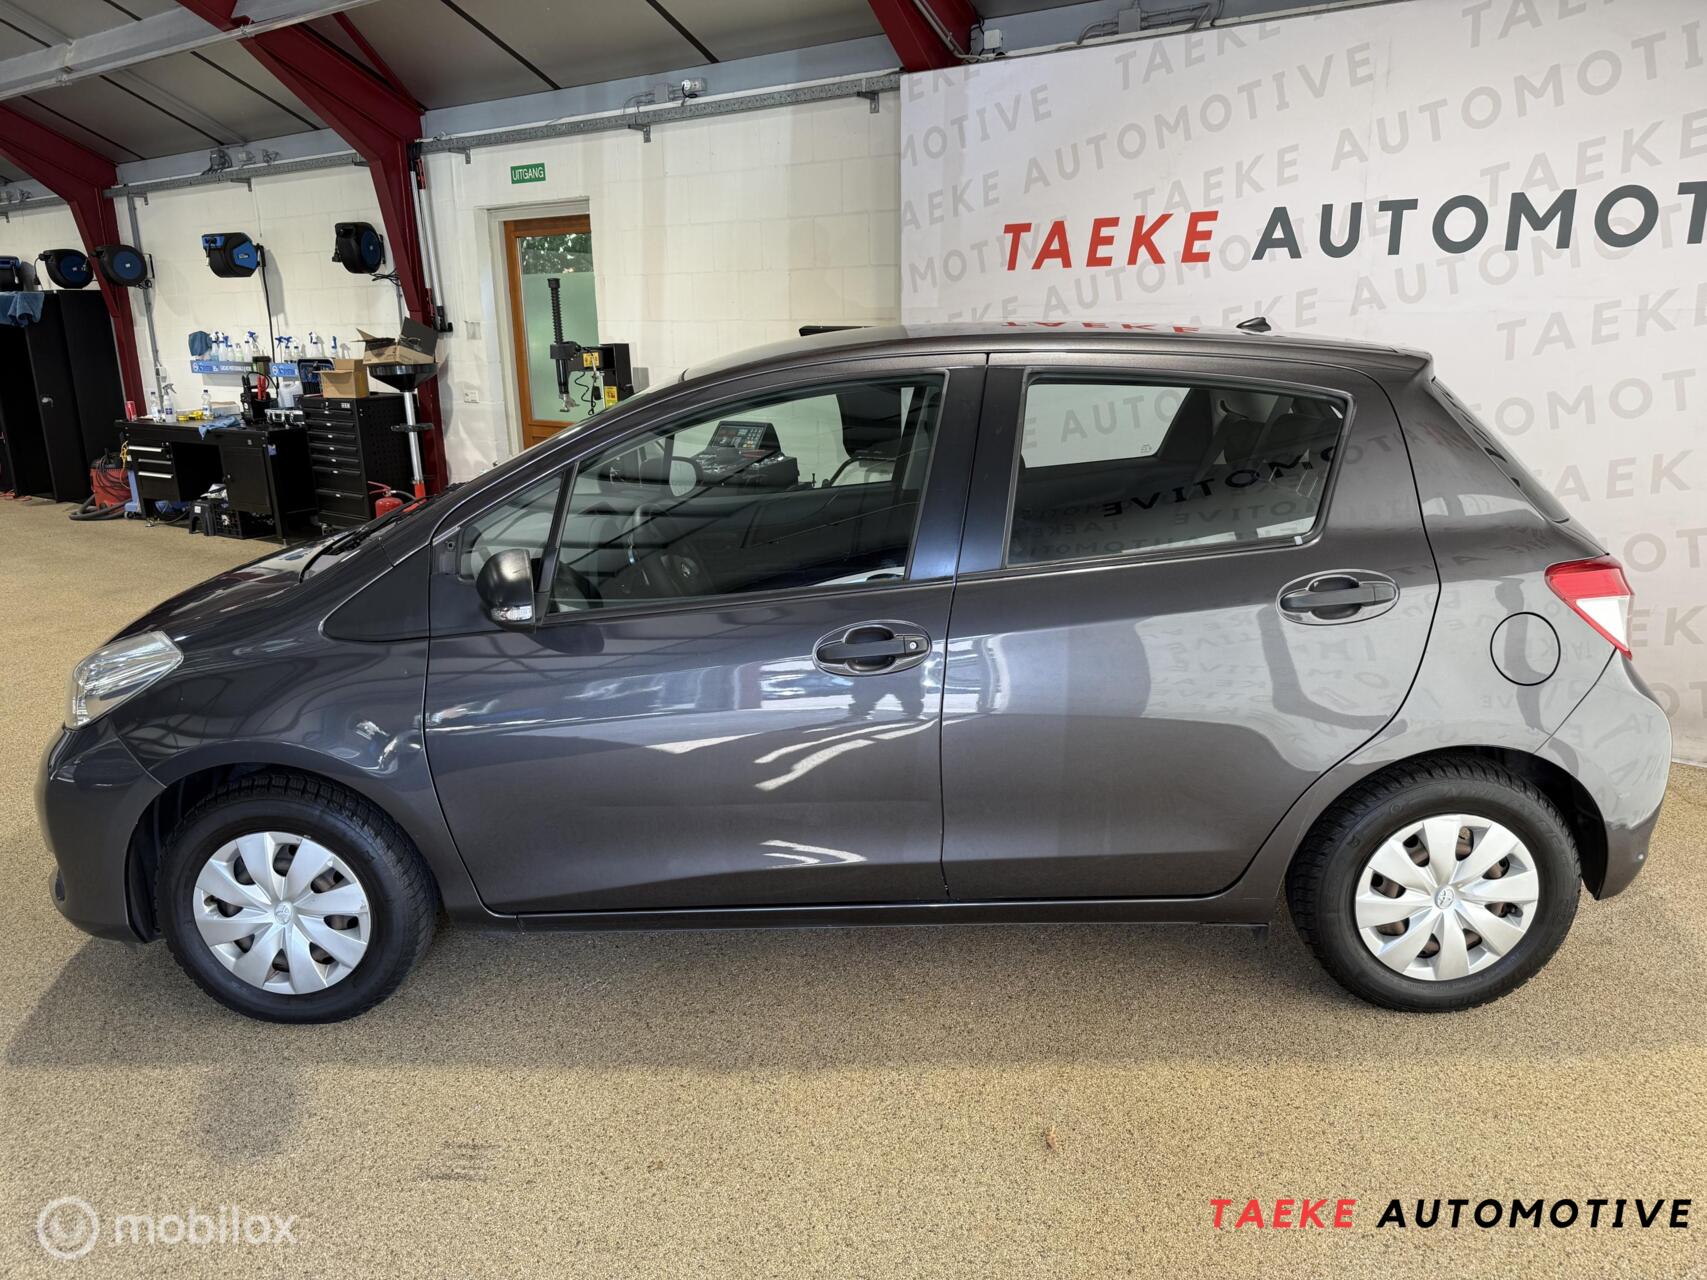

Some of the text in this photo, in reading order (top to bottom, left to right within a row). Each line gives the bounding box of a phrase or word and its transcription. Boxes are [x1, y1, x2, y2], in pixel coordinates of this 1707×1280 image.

[1024, 42, 1374, 194] AUTOMOTIVE
[1133, 144, 1299, 215] TAEKE
[1331, 20, 1705, 171] AUTOMOTI
[512, 166, 544, 181] UITGANG
[1003, 181, 1707, 271] TAEKE AUTOMOT
[1470, 368, 1696, 436] OMOT
[1534, 449, 1694, 502] AEK
